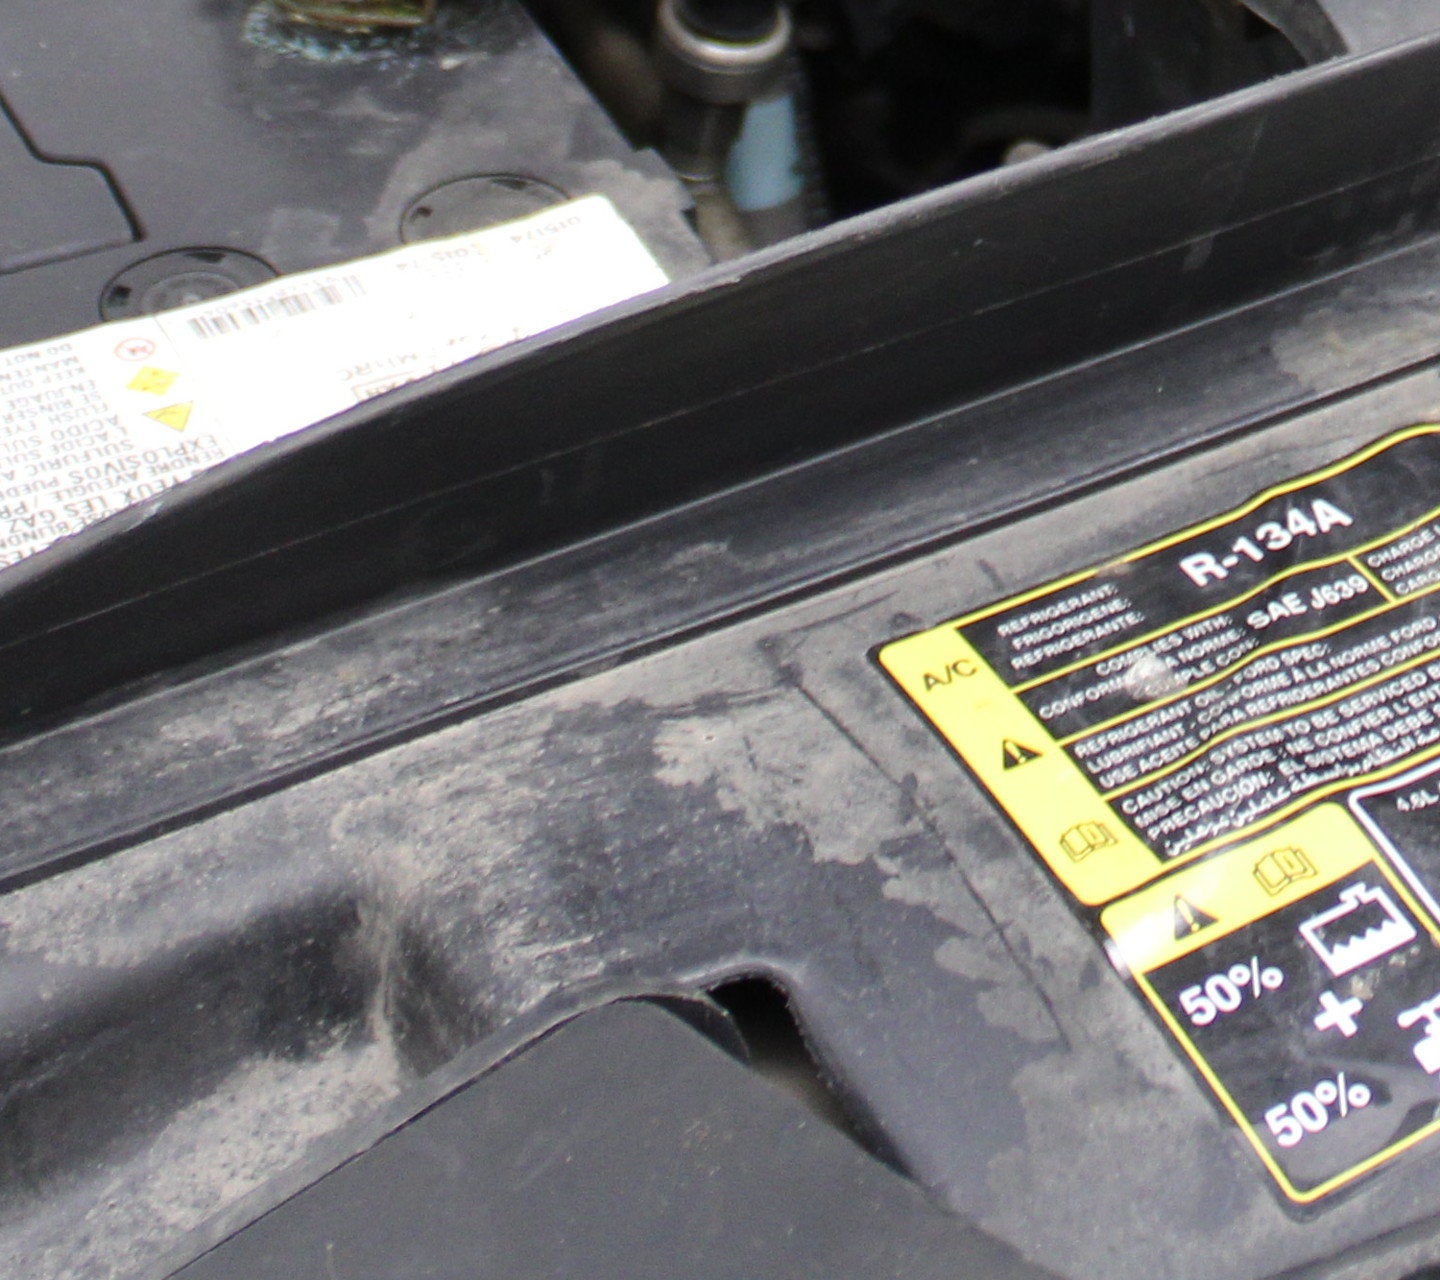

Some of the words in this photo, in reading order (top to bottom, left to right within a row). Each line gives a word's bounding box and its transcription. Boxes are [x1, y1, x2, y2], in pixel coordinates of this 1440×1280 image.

[66, 433, 217, 485] EXPLOSIVOS
[7, 508, 57, 535] GAZ
[61, 494, 109, 518] LES
[1180, 499, 1352, 586] R-134A
[1367, 529, 1435, 567] CHARGE
[1247, 593, 1307, 628] SAE
[1311, 574, 1368, 609] J639
[922, 659, 977, 691] A/C
[1074, 697, 1203, 757] REFRIGERANT
[1087, 722, 1185, 773] LUBRIFIANT
[1209, 727, 1284, 771] SYSTEM
[1281, 718, 1311, 737] TO
[1310, 709, 1339, 728] BE
[1338, 671, 1427, 717] SERVICED
[1304, 725, 1384, 767] SISTEMA
[1381, 709, 1434, 740] DEBE
[1099, 764, 1136, 788] USE
[1129, 736, 1207, 774] ACEITE
[1132, 796, 1189, 828] MISE
[1181, 778, 1211, 800] EN
[1210, 748, 1277, 785] GARDE
[1314, 706, 1394, 746] CONFIER
[1179, 956, 1283, 1024] 50%
[1265, 1072, 1370, 1146] 50%
